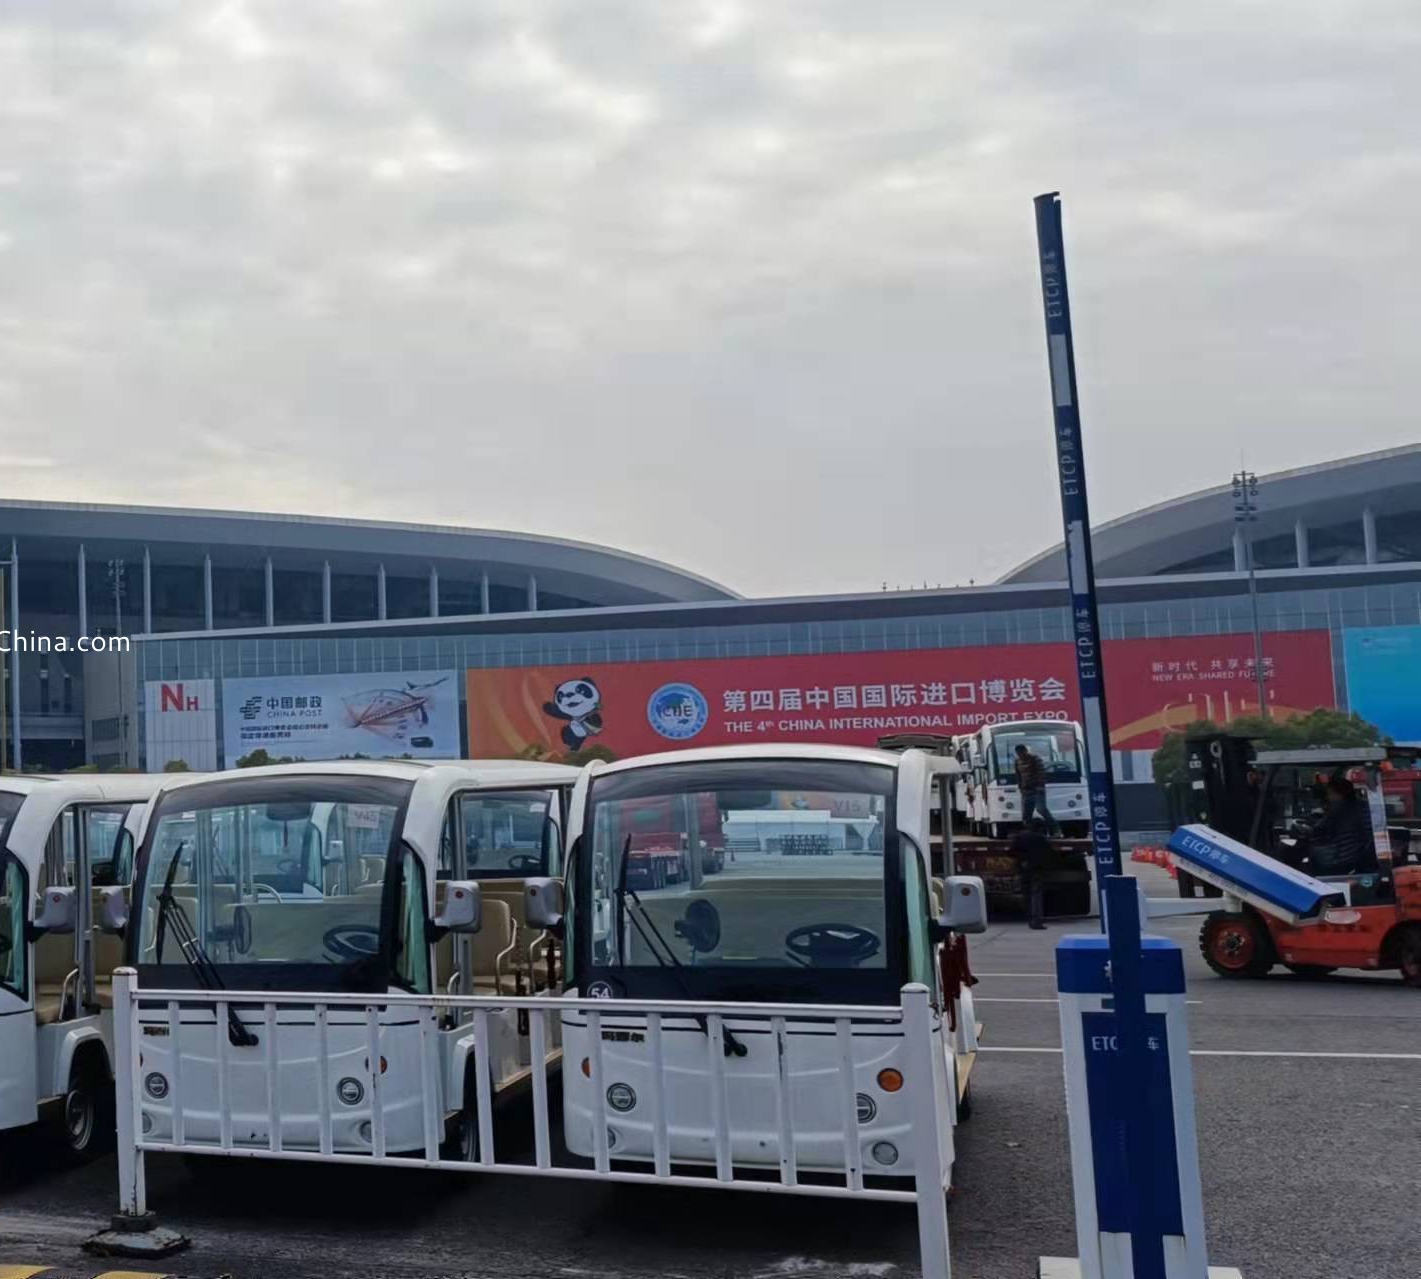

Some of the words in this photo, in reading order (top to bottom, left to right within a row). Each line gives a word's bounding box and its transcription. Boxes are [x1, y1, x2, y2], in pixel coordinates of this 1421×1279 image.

[1199, 671, 1235, 680] SHARED
[1239, 669, 1275, 678] FUE
[266, 695, 322, 710] 中国邮政
[723, 677, 1066, 713] 第四届中国国际进口博览会
[267, 710, 296, 718] CHINA
[724, 721, 753, 733] THE
[779, 719, 825, 731] CHINA
[829, 715, 953, 730] INTERNATIONAL
[957, 711, 1018, 726] IMPORT
[1024, 710, 1068, 722] EXPO
